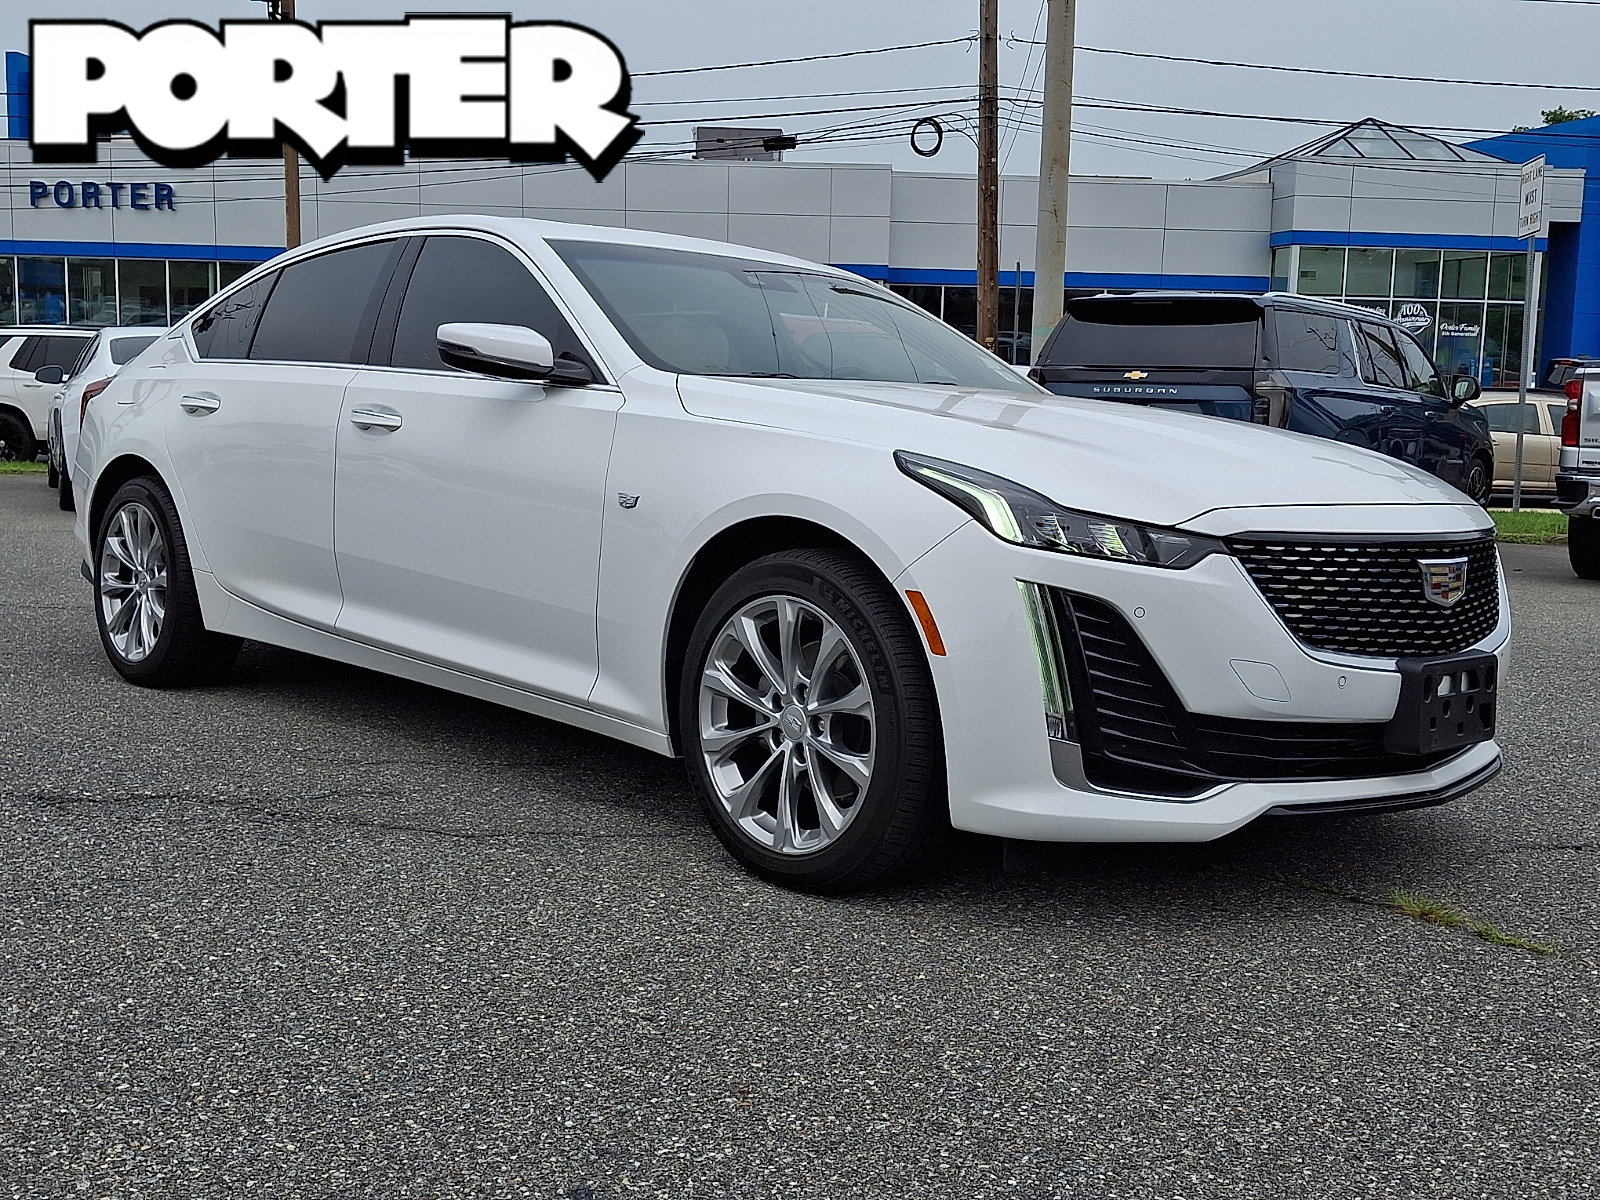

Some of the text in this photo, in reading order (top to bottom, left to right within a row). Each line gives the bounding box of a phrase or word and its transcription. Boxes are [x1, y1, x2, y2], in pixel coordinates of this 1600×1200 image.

[1532, 166, 1543, 180] LANE
[29, 180, 176, 211] PORTER
[1525, 188, 1538, 206] MUST
[1459, 323, 1480, 334] Family
[1093, 386, 1178, 394] SUBURBAN
[835, 598, 892, 690] MICHELIN
